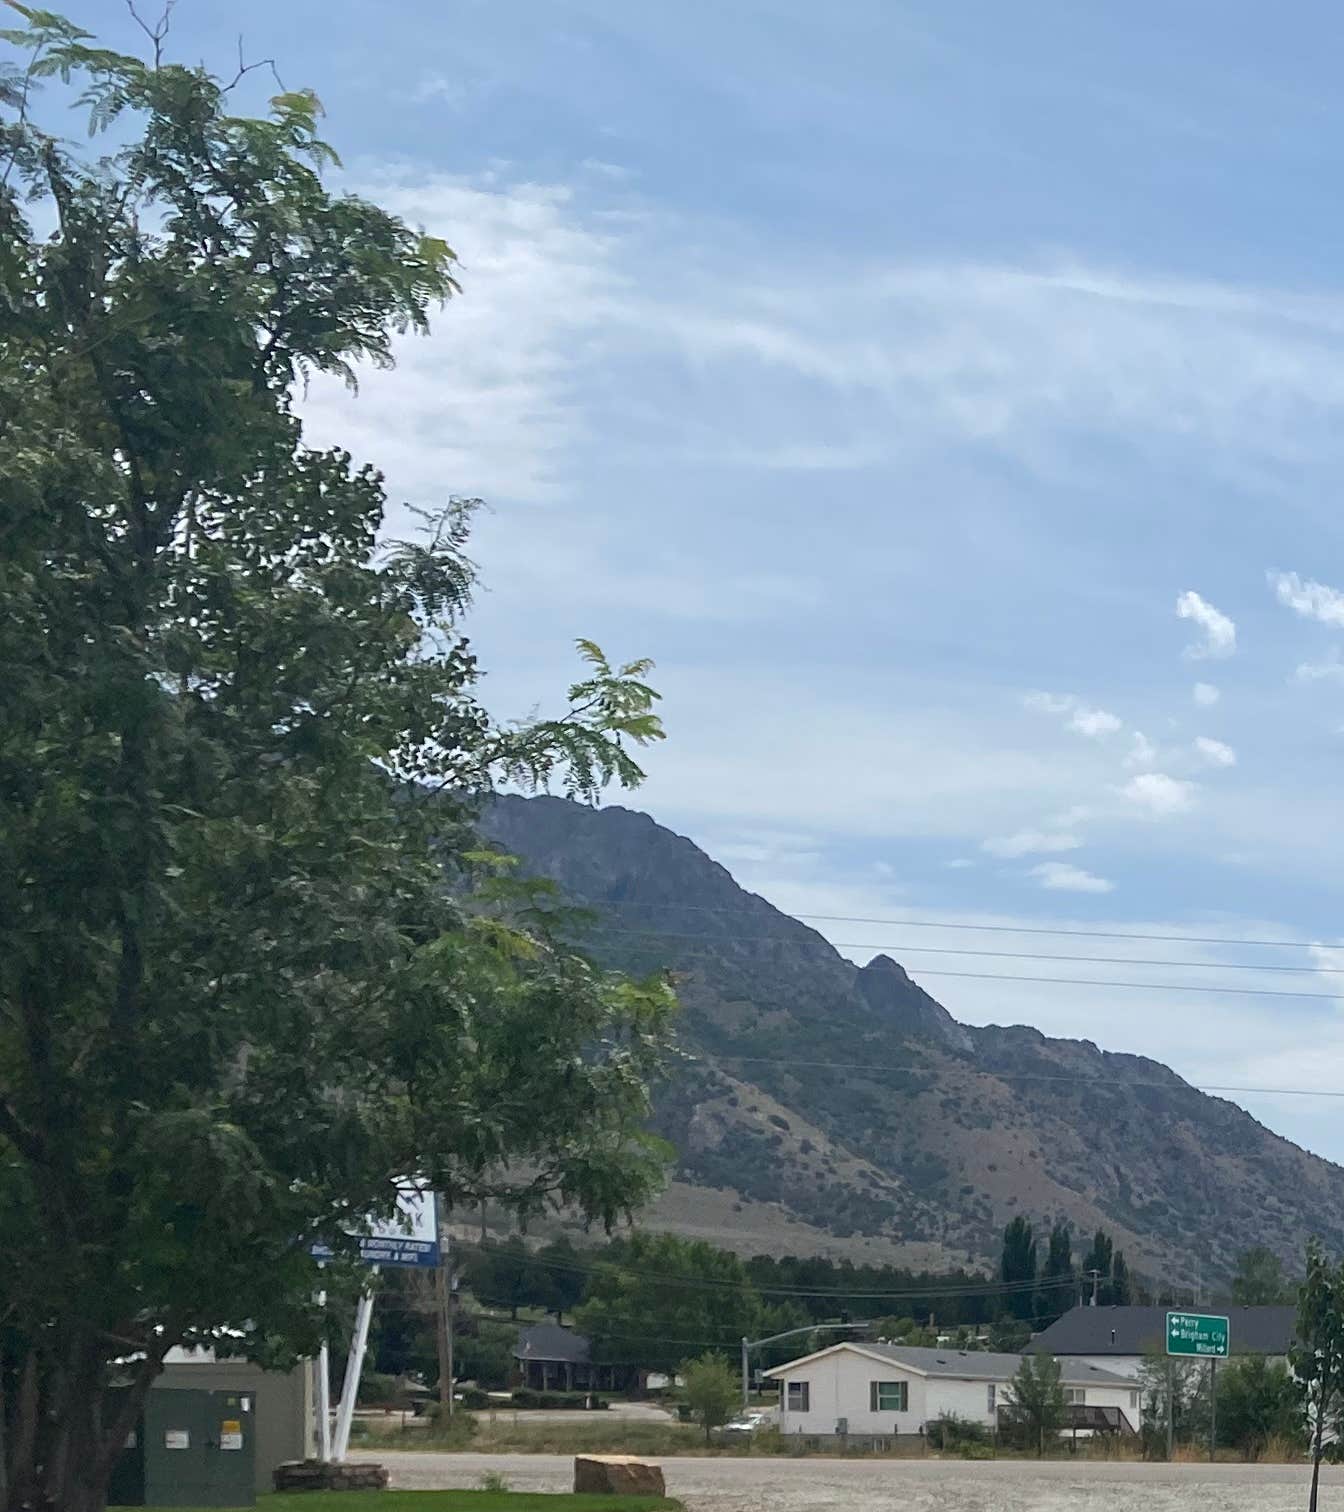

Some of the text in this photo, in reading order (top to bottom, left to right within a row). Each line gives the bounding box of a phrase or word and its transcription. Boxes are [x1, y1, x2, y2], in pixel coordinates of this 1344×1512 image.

[1180, 1316, 1199, 1329] Perry
[1180, 1328, 1225, 1343] Brigham City
